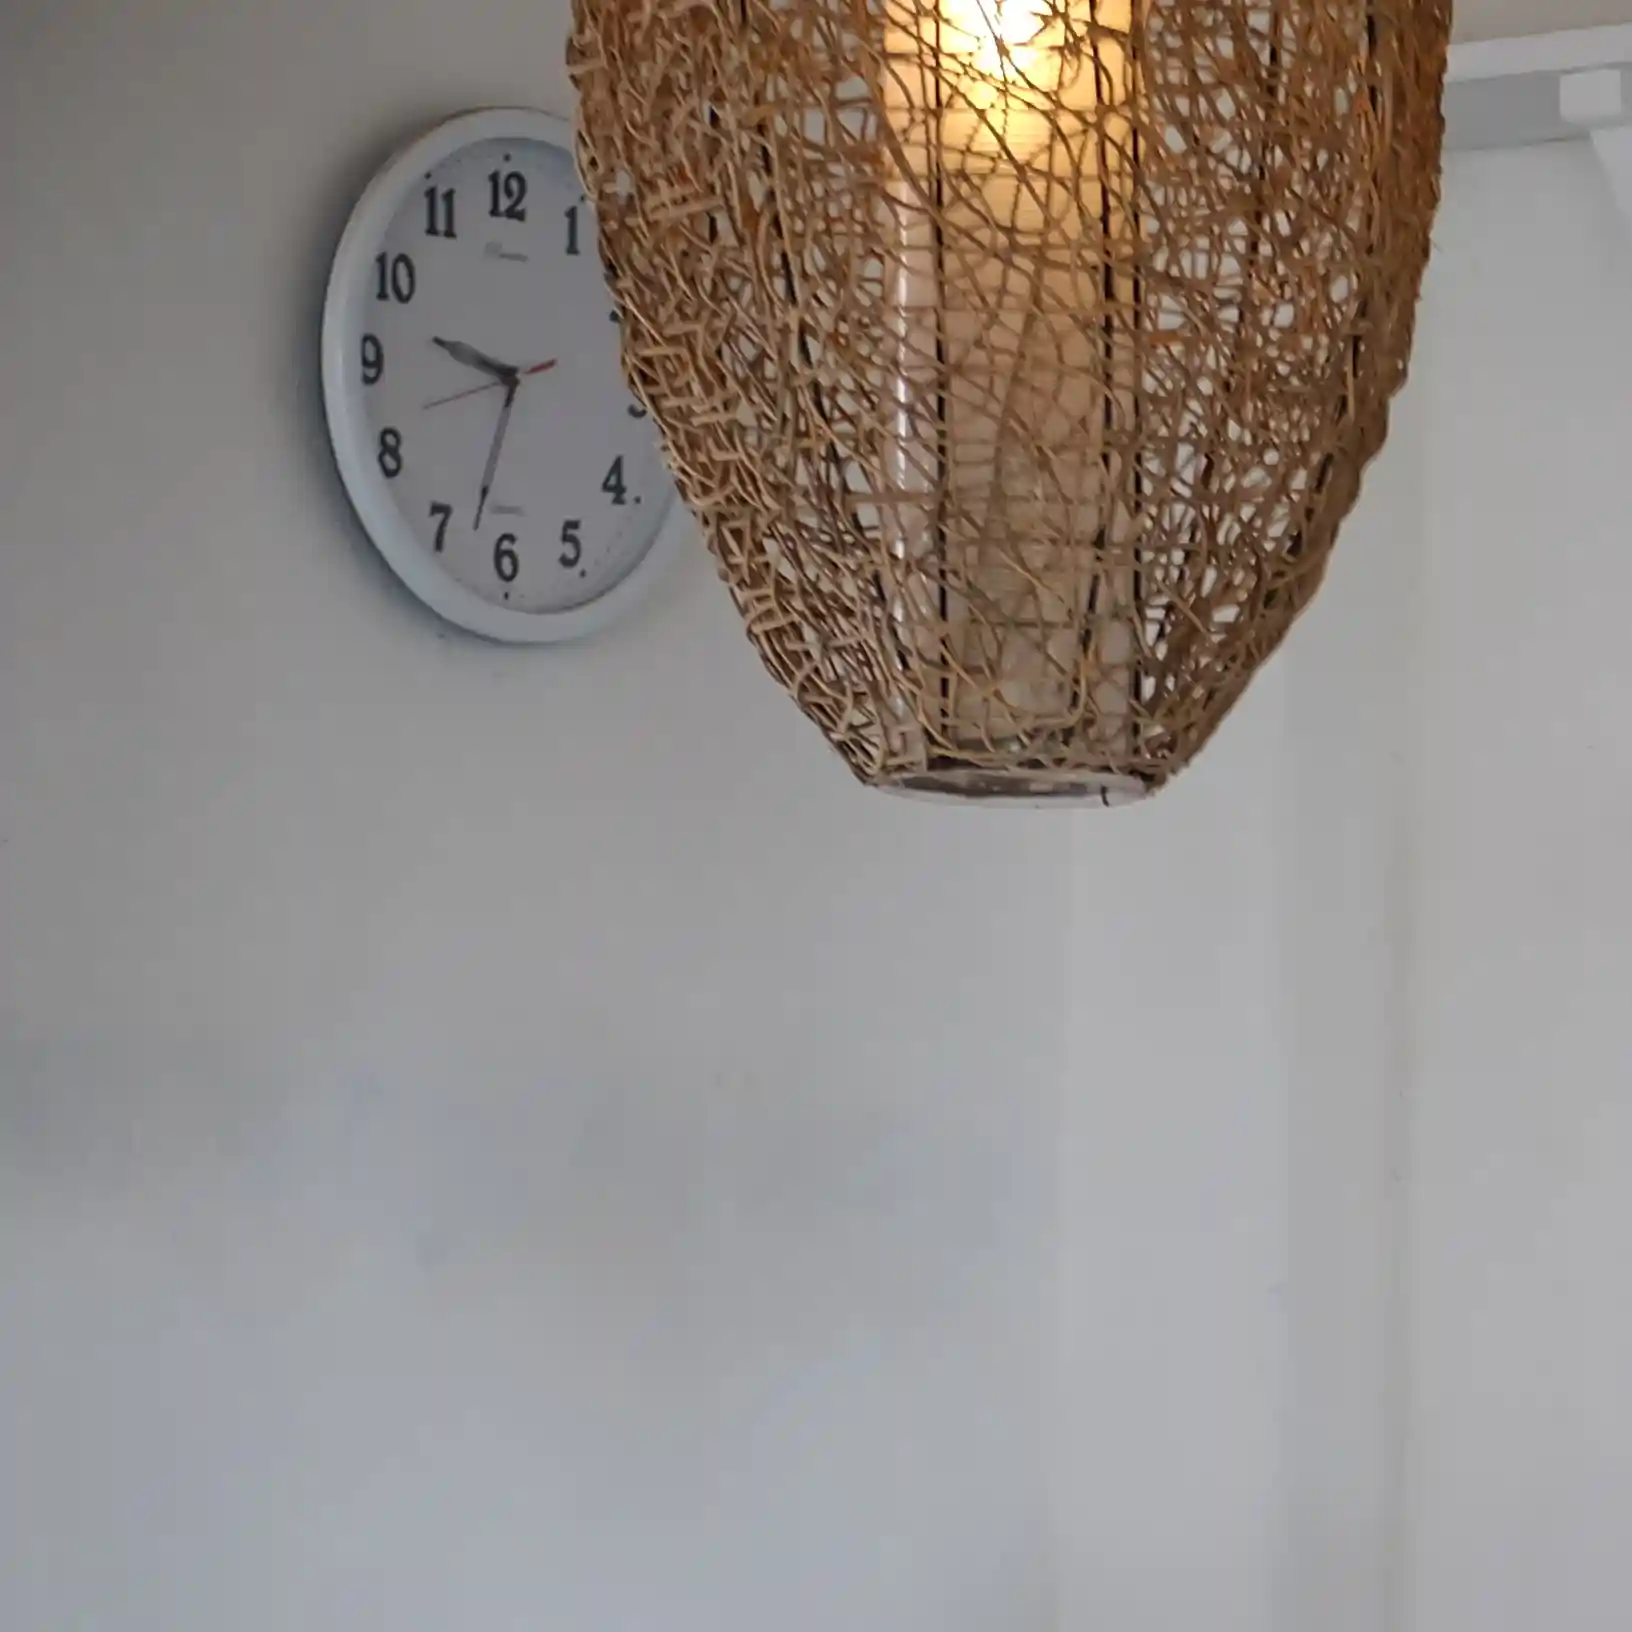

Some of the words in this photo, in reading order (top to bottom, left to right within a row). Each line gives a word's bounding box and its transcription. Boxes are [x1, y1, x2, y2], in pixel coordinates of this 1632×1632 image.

[423, 185, 458, 239] 11
[488, 171, 527, 222] 12
[564, 204, 581, 256] 1
[375, 251, 417, 304] 10
[360, 333, 385, 385] 9
[378, 426, 403, 479] 8
[602, 455, 628, 505] 4
[428, 502, 453, 552] 7
[558, 519, 582, 568] 5
[493, 532, 520, 583] 6
